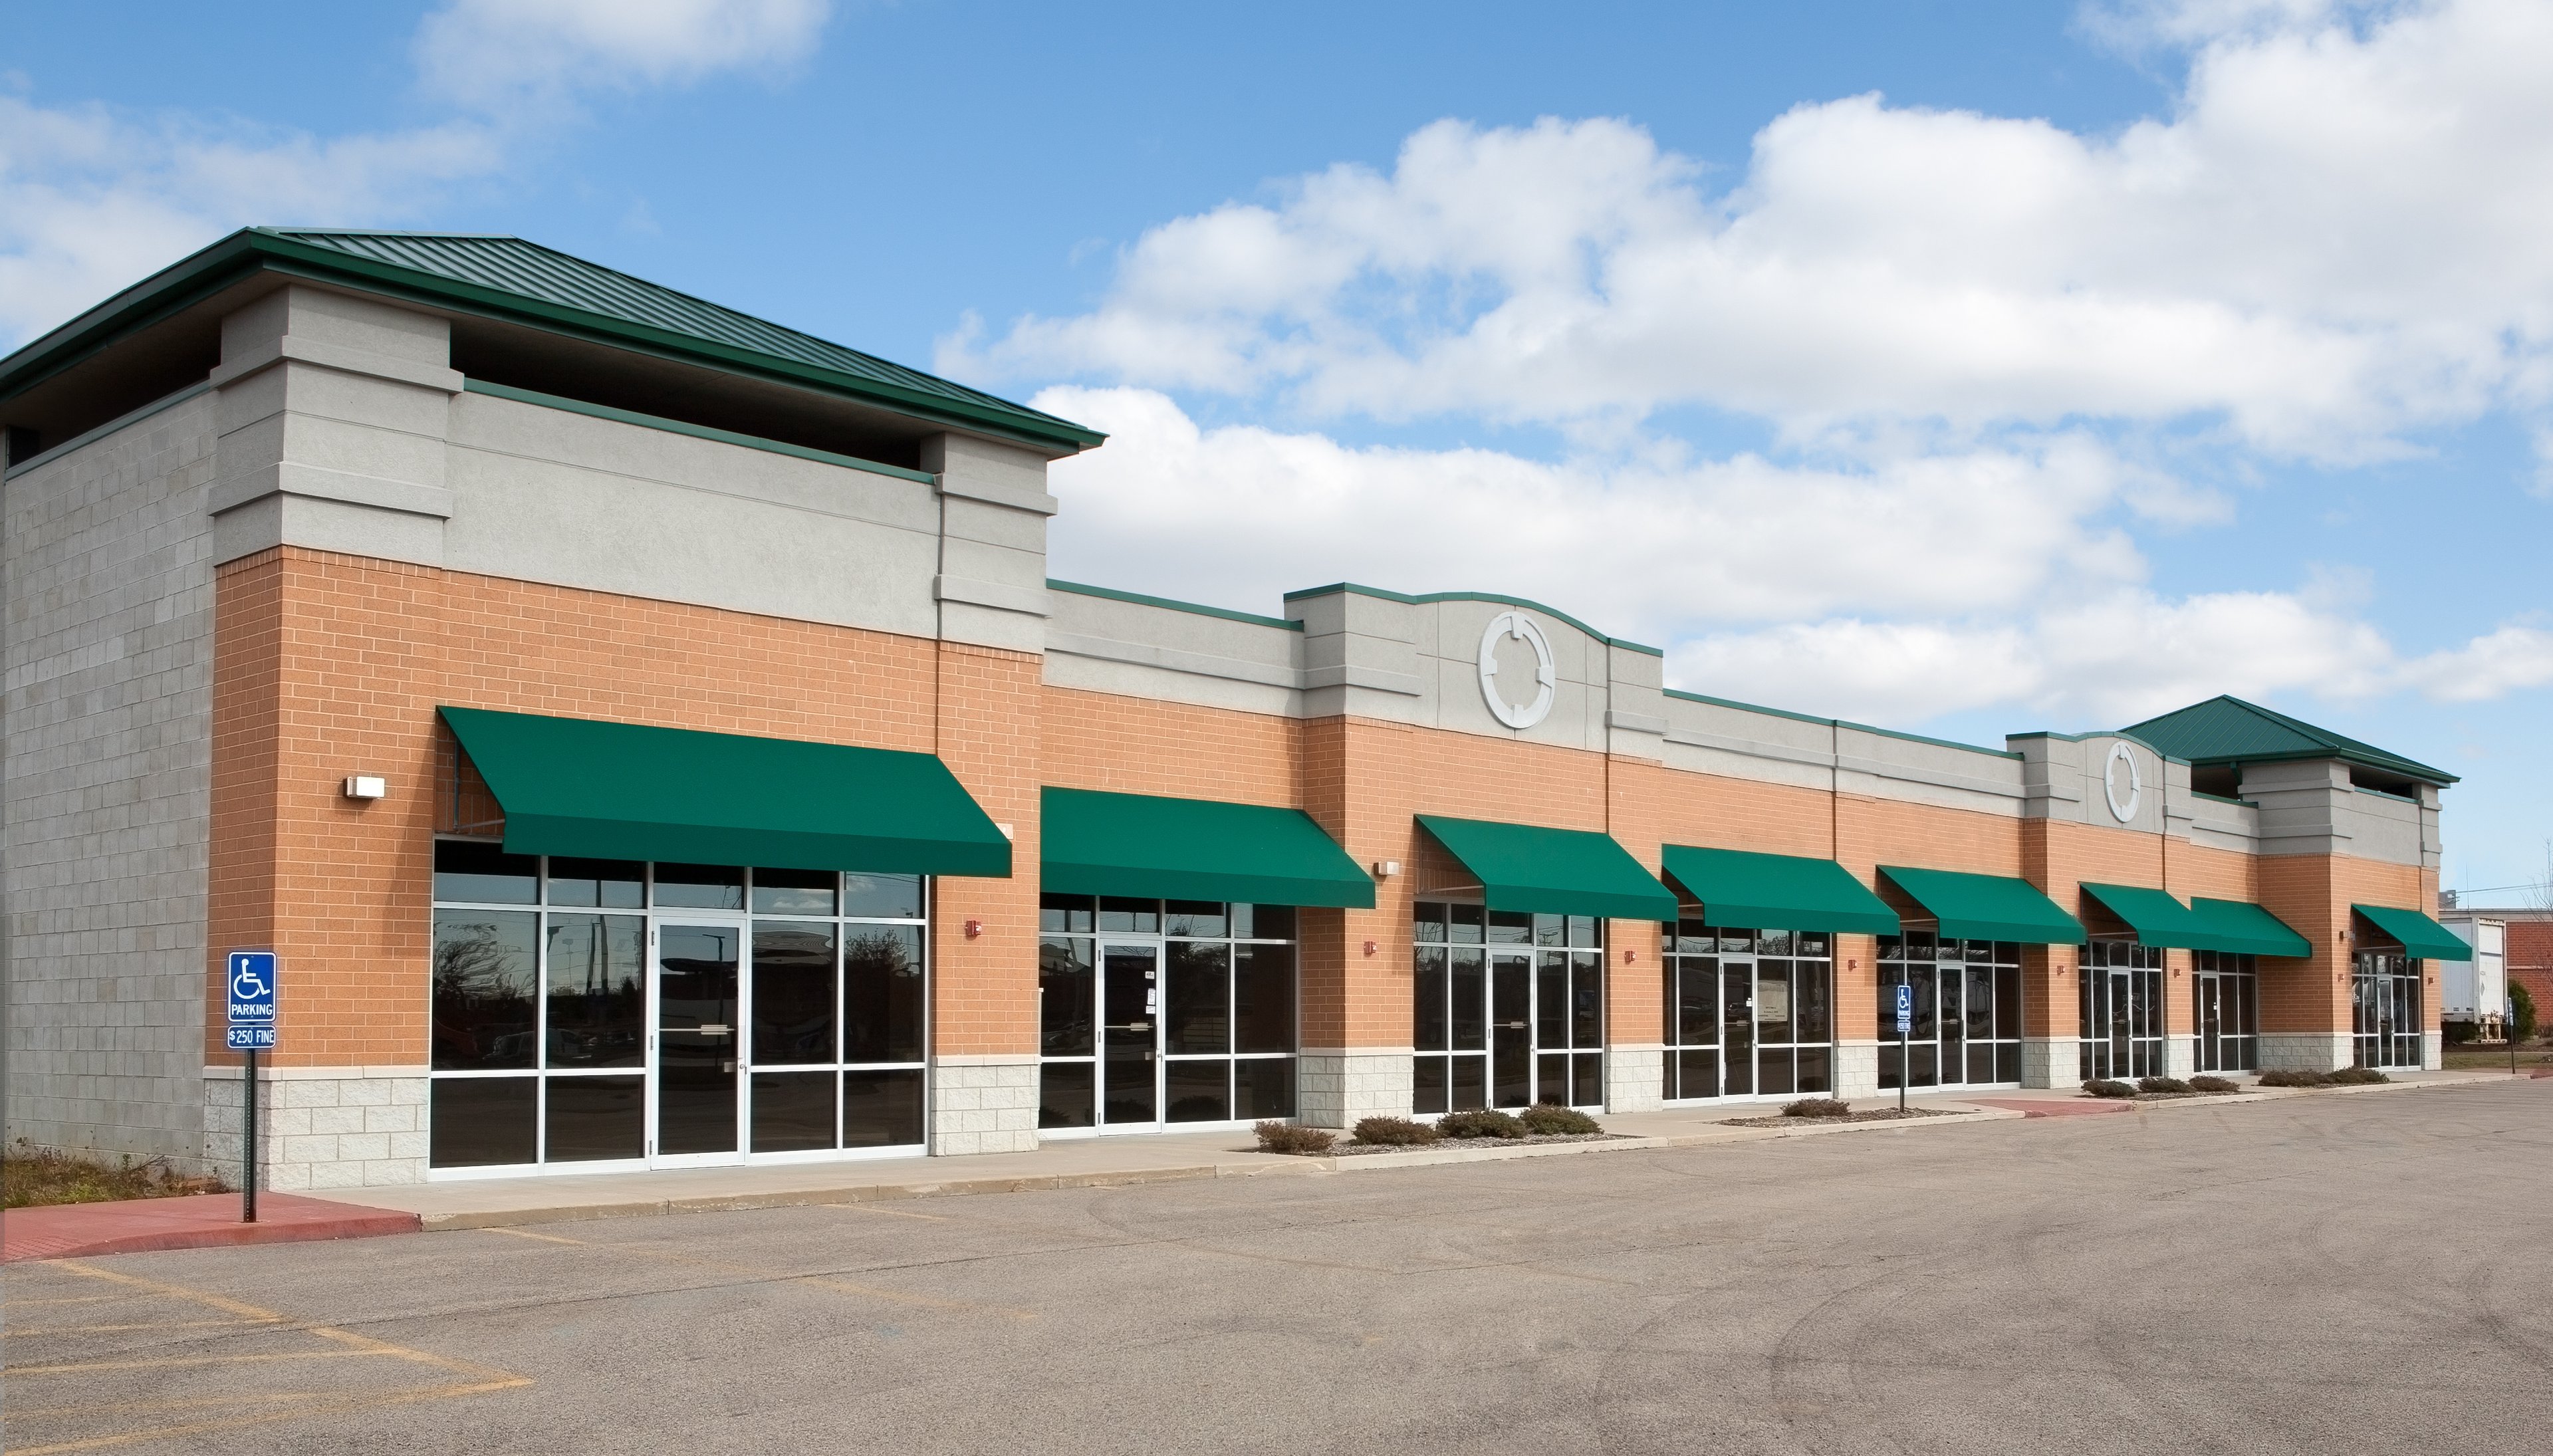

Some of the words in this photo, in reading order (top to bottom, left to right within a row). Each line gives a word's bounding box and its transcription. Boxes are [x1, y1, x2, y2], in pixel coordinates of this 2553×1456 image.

[231, 1004, 273, 1015] PARKING
[229, 1030, 253, 1044] $250
[257, 1030, 275, 1043] FINE
